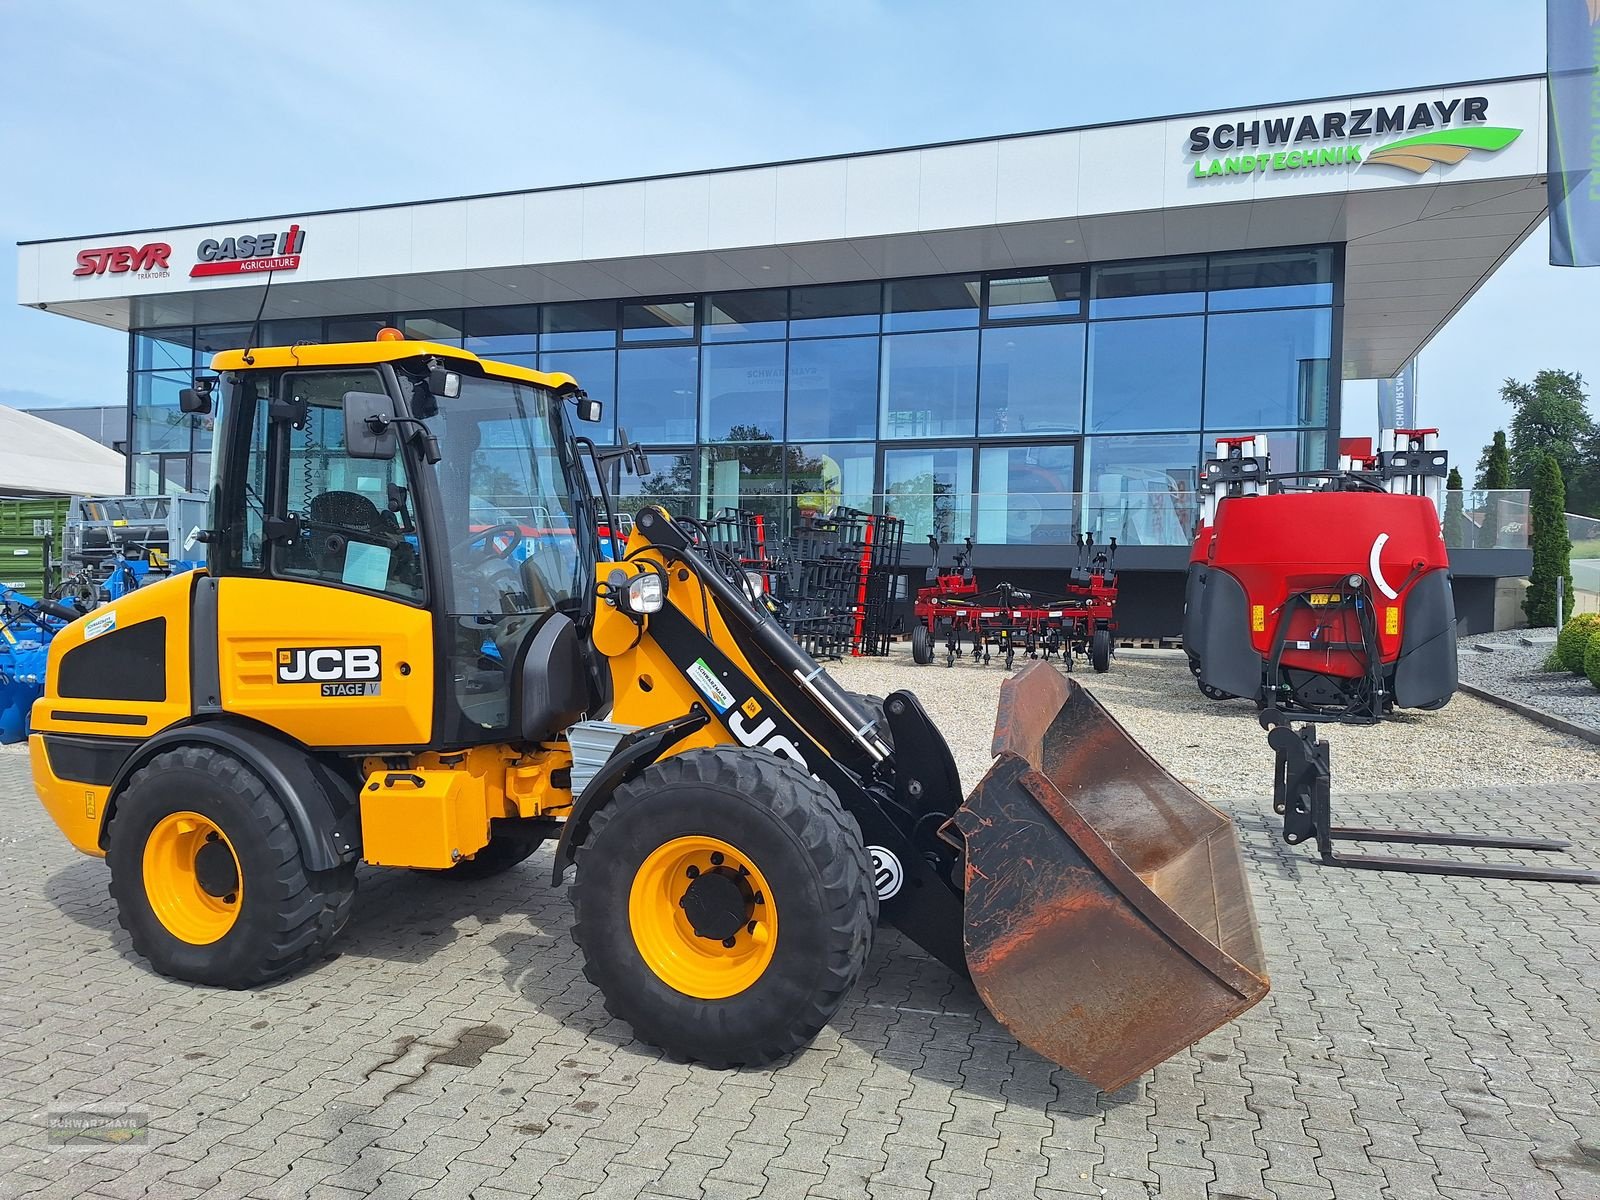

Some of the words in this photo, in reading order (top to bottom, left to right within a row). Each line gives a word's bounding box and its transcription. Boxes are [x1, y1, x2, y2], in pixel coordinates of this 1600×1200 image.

[1190, 96, 1489, 153] SCHWARZMAYR
[1194, 144, 1362, 178] LANDTECHNIK
[73, 242, 172, 276] STEYR
[197, 233, 277, 262] CASE
[137, 271, 171, 280] TRAKTOREN
[240, 257, 295, 271] AGRICULTURE
[280, 649, 380, 681] JCB
[322, 683, 363, 696] STAGE
[369, 683, 378, 695] V
[728, 710, 820, 782] JC
